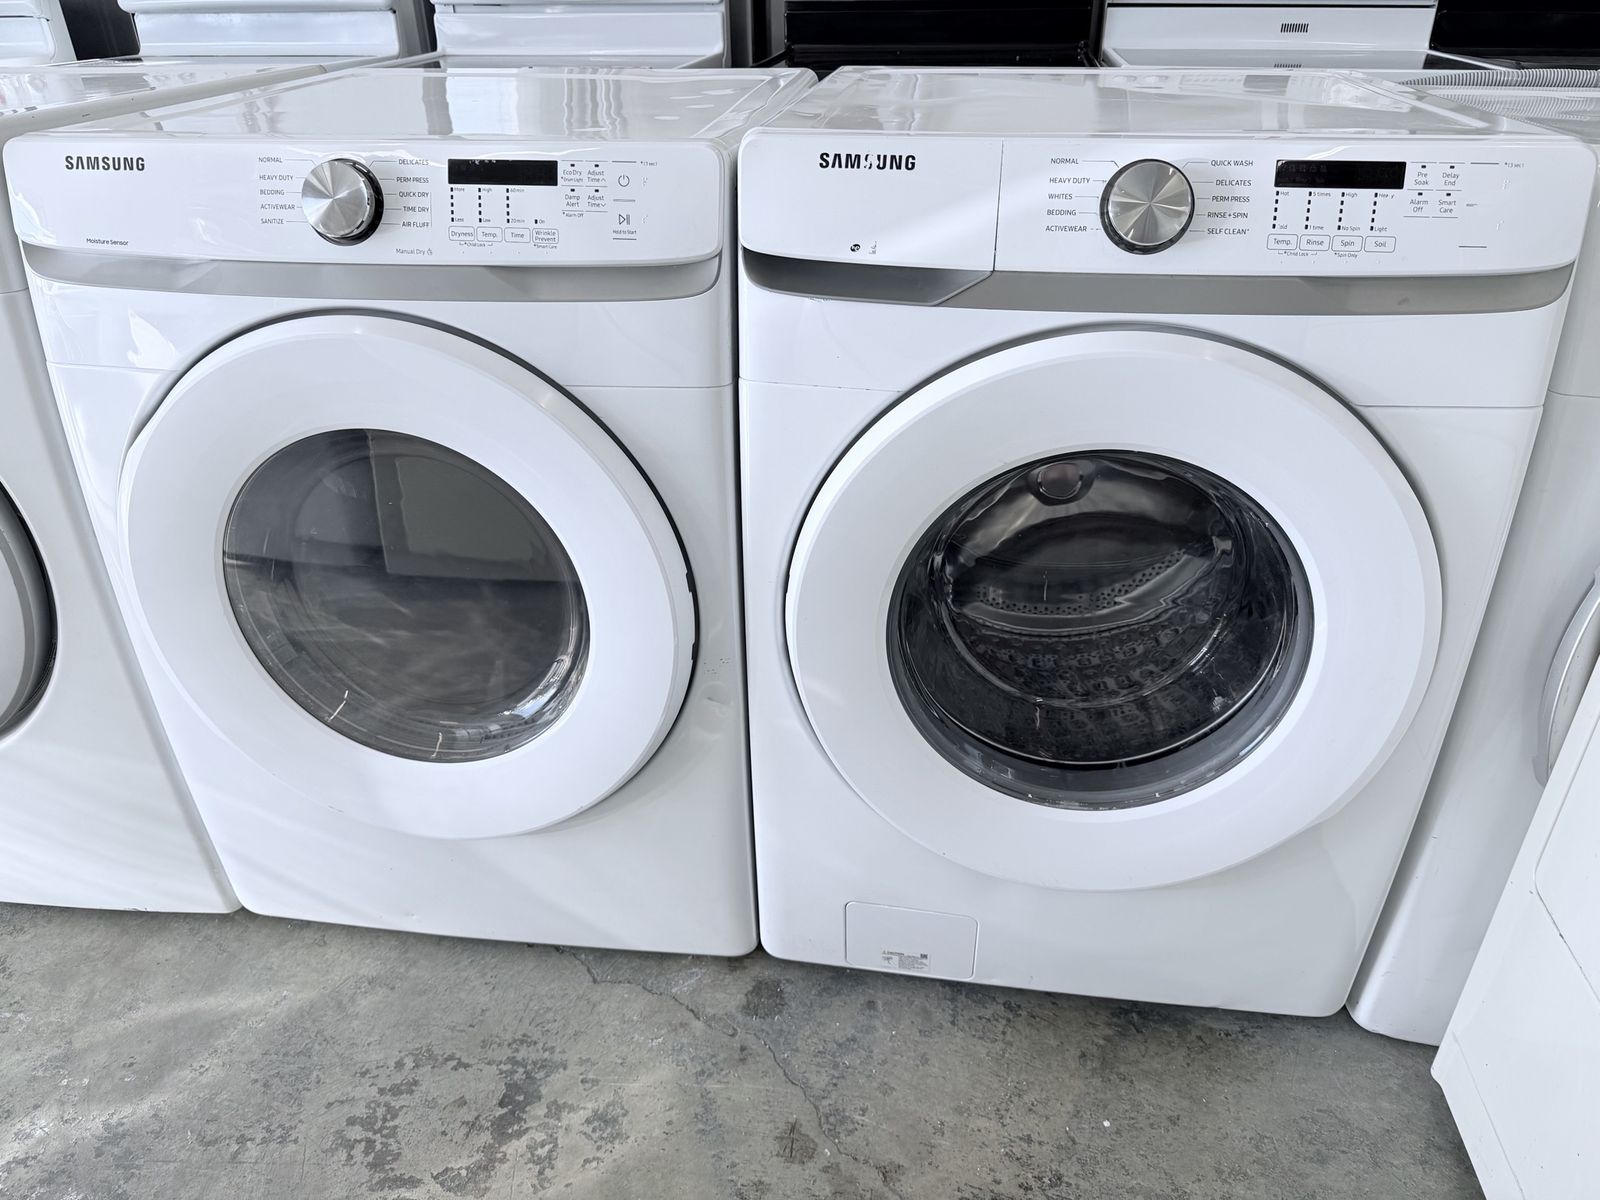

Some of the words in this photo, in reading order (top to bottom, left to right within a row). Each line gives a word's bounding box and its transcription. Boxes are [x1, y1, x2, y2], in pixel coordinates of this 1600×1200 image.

[65, 155, 145, 171] SAMSUNG
[451, 231, 474, 239] Dryness
[1273, 238, 1292, 246] Temp.
[1340, 240, 1355, 248] Spin
